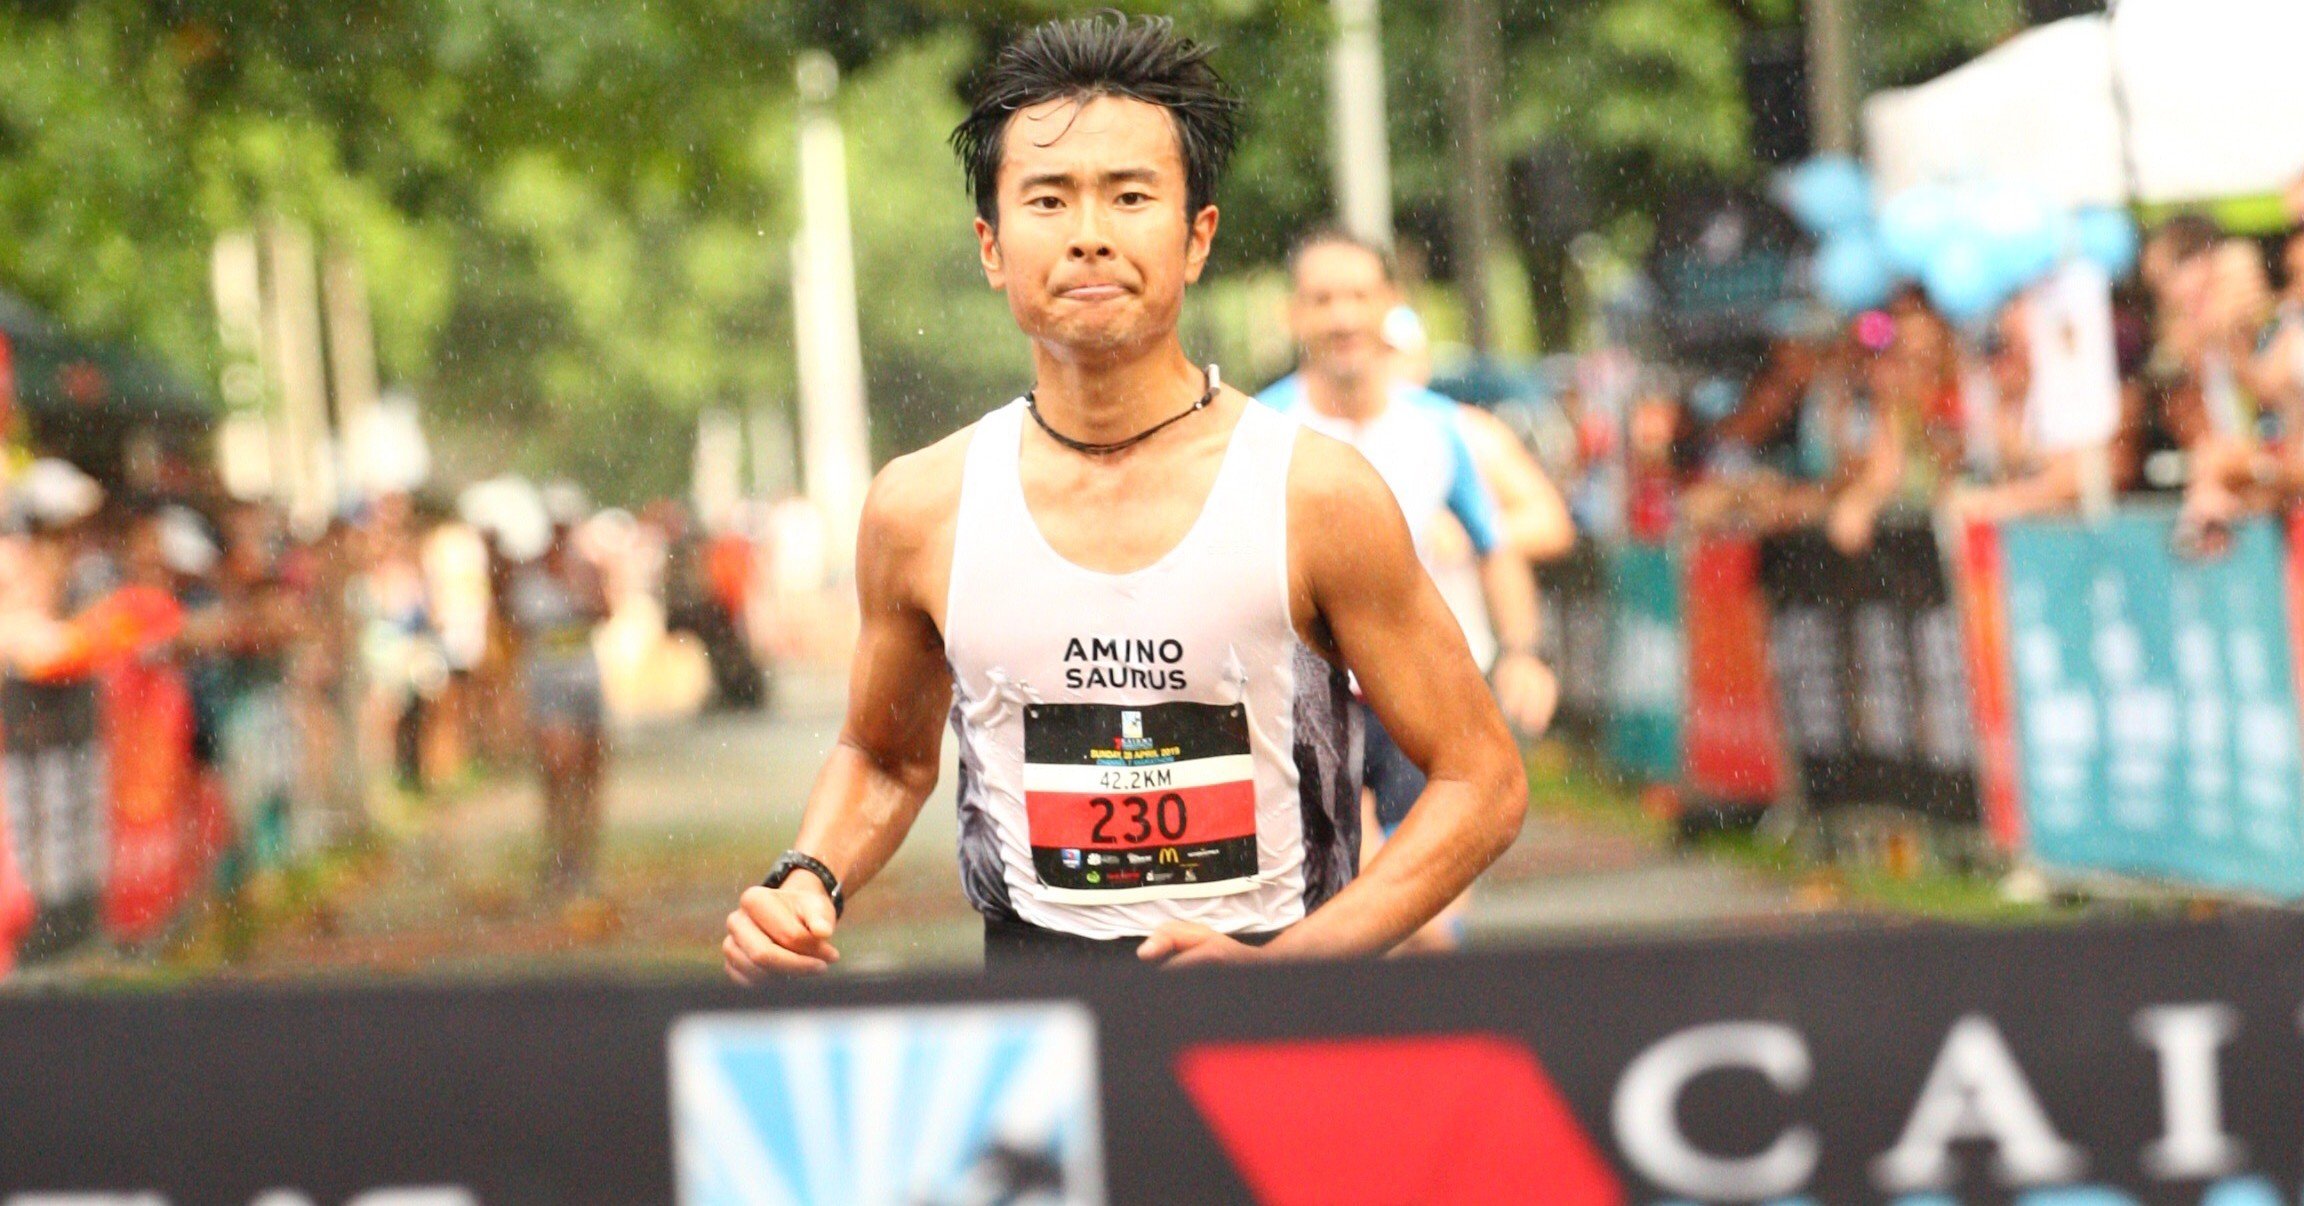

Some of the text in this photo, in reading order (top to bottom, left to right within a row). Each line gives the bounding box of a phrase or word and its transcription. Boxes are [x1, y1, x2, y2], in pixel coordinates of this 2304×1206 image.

[1063, 637, 1184, 664] AMINO
[1066, 668, 1187, 690] SAURUS
[1100, 768, 1172, 790] 42.2KM
[1089, 792, 1188, 844] 230
[1610, 1002, 2304, 1200] CAI
